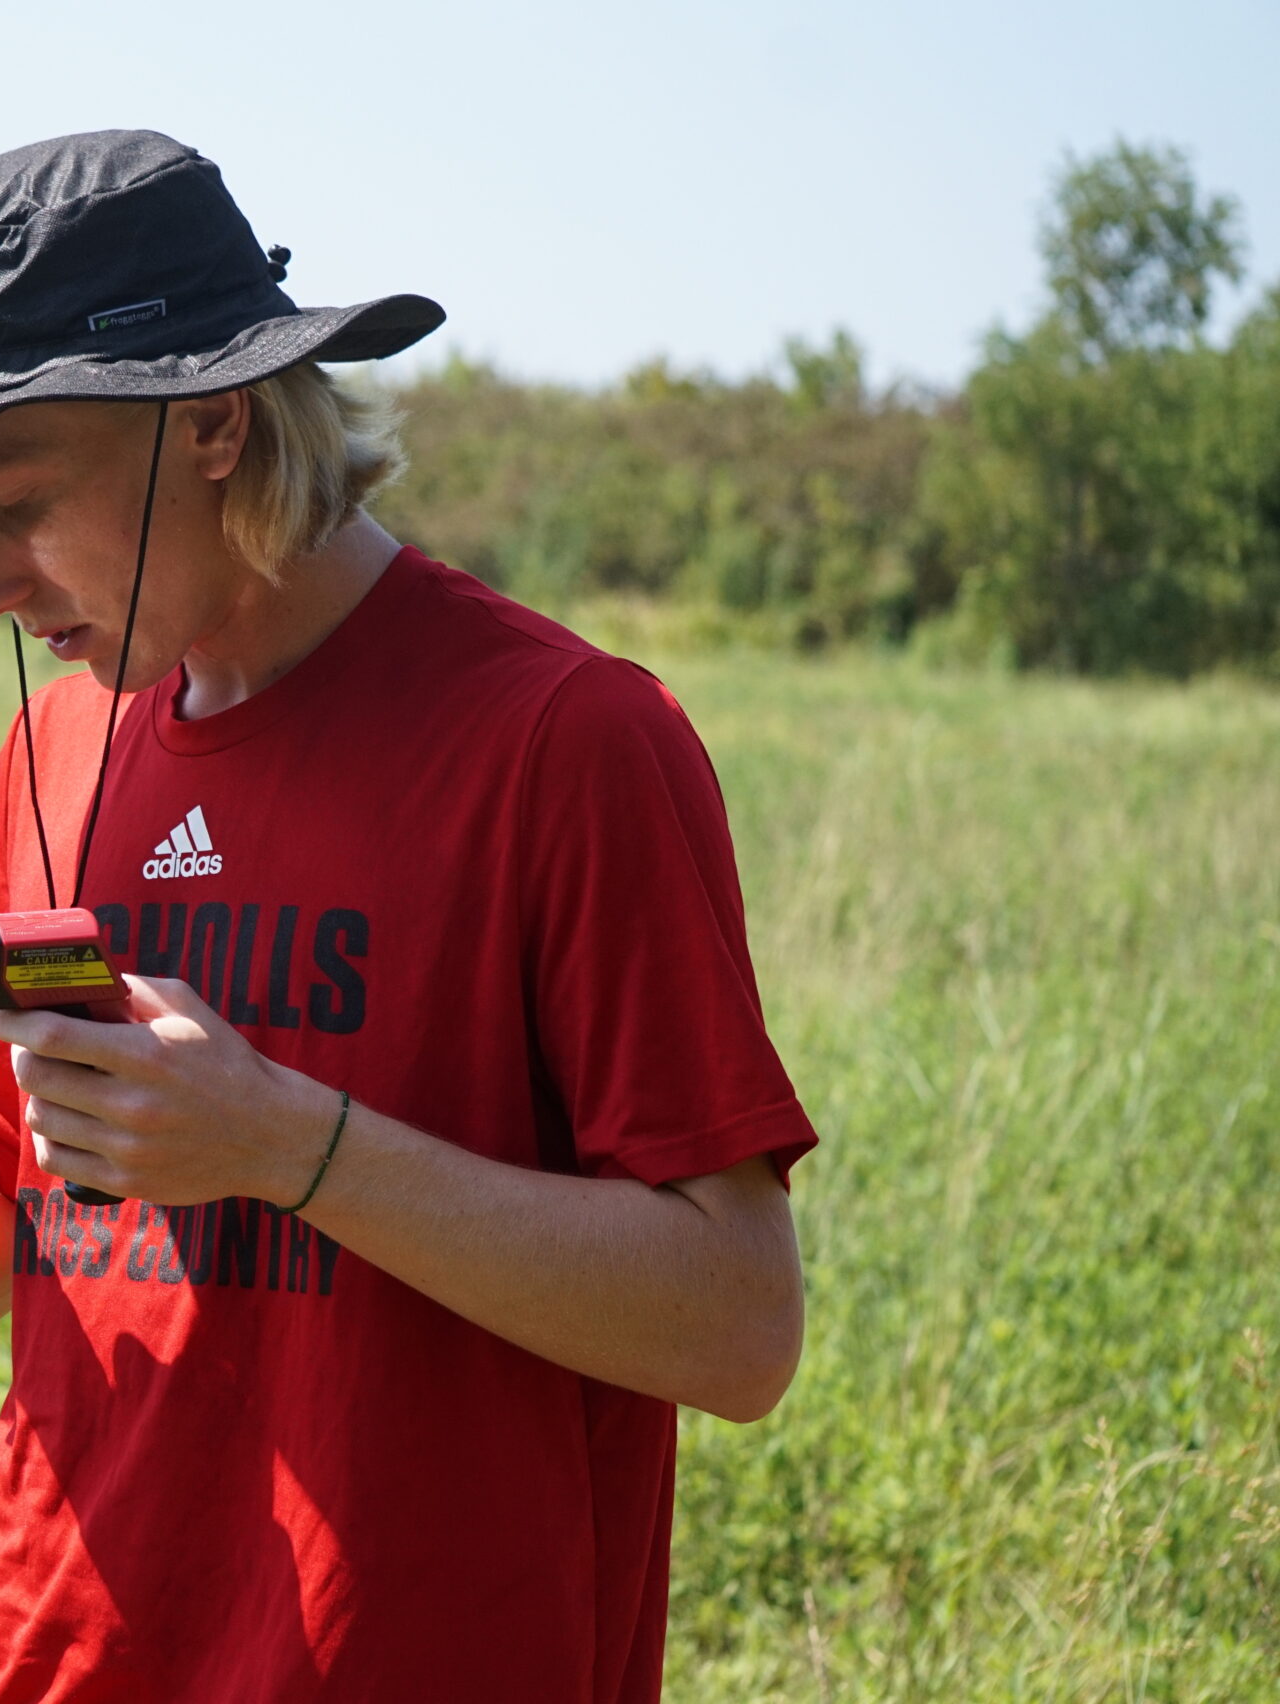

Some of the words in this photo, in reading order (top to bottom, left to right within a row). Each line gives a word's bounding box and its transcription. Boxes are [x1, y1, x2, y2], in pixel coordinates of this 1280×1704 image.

[142, 850, 223, 880] adidas
[26, 954, 77, 965] CAUTION
[126, 1197, 342, 1296] COUNTRY
